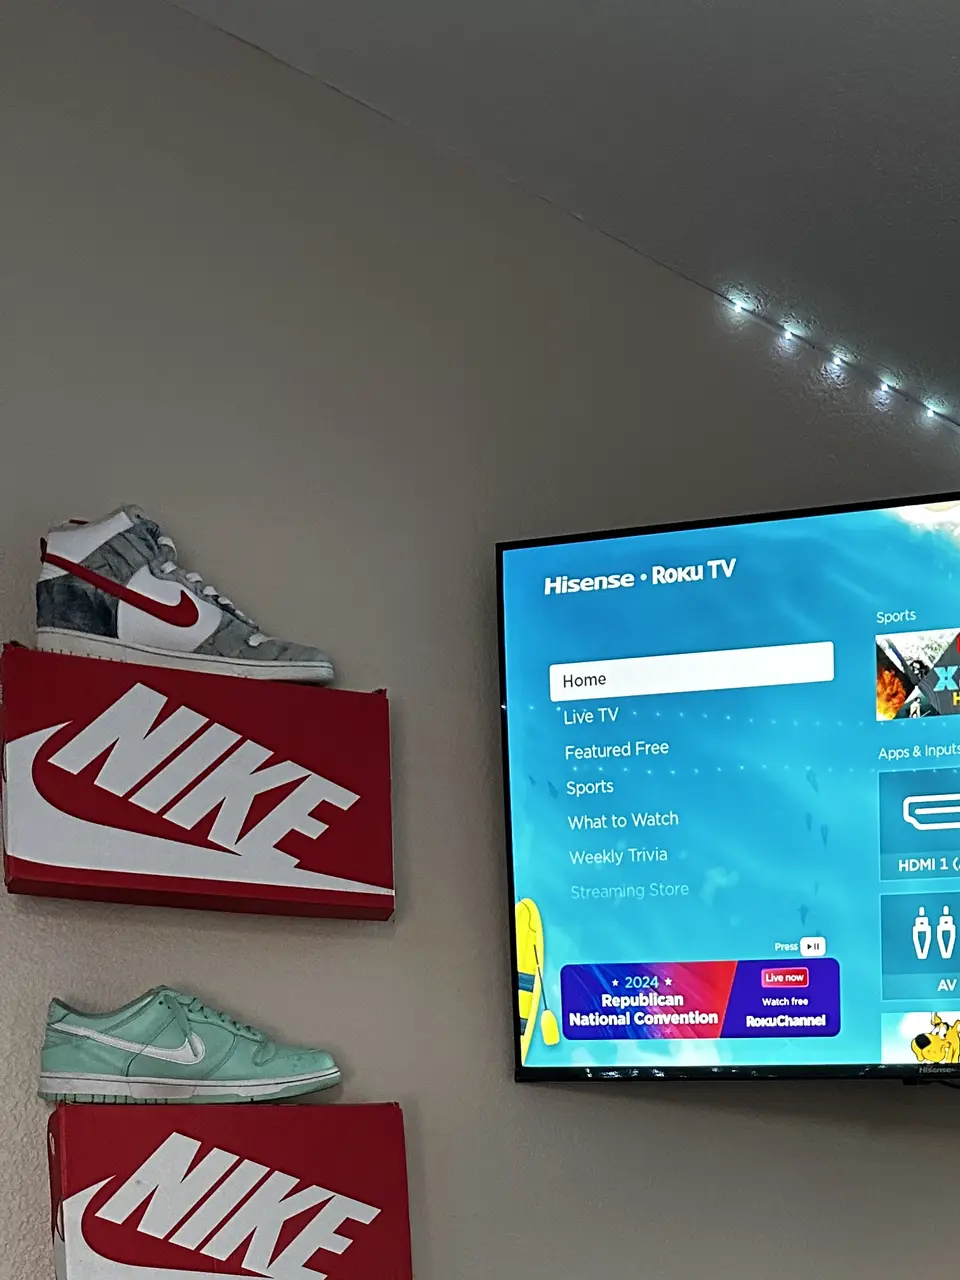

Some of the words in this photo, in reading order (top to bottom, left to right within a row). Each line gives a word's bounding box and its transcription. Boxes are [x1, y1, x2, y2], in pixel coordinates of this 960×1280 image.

[544, 572, 635, 596] Hisense
[651, 564, 704, 585] Roku
[707, 558, 737, 579] TV
[876, 609, 917, 625] Sports
[563, 672, 607, 689] Home
[563, 709, 594, 726] Live
[598, 707, 619, 723] TV
[565, 742, 631, 760] Featured
[635, 740, 669, 756] Free
[878, 748, 910, 761] Apps
[912, 746, 922, 757] &
[48, 682, 361, 868] NIKE
[566, 779, 614, 797] Sports
[567, 814, 607, 830] What
[612, 814, 627, 829] to
[631, 811, 679, 828] Watch
[569, 848, 623, 866] Weekly
[627, 846, 668, 862] Trivia
[898, 857, 935, 872] HDMI
[939, 857, 948, 870] 1
[570, 883, 645, 900] Streaming
[649, 883, 689, 897] Store
[774, 941, 799, 952] Press
[625, 976, 660, 989] 2024
[765, 972, 784, 983] Live
[784, 972, 805, 983] now
[936, 978, 958, 992] AV
[601, 992, 684, 1010] Republican
[762, 997, 790, 1007] Watch
[790, 996, 809, 1006] free
[569, 1011, 631, 1027] National
[633, 1010, 719, 1025] Convention
